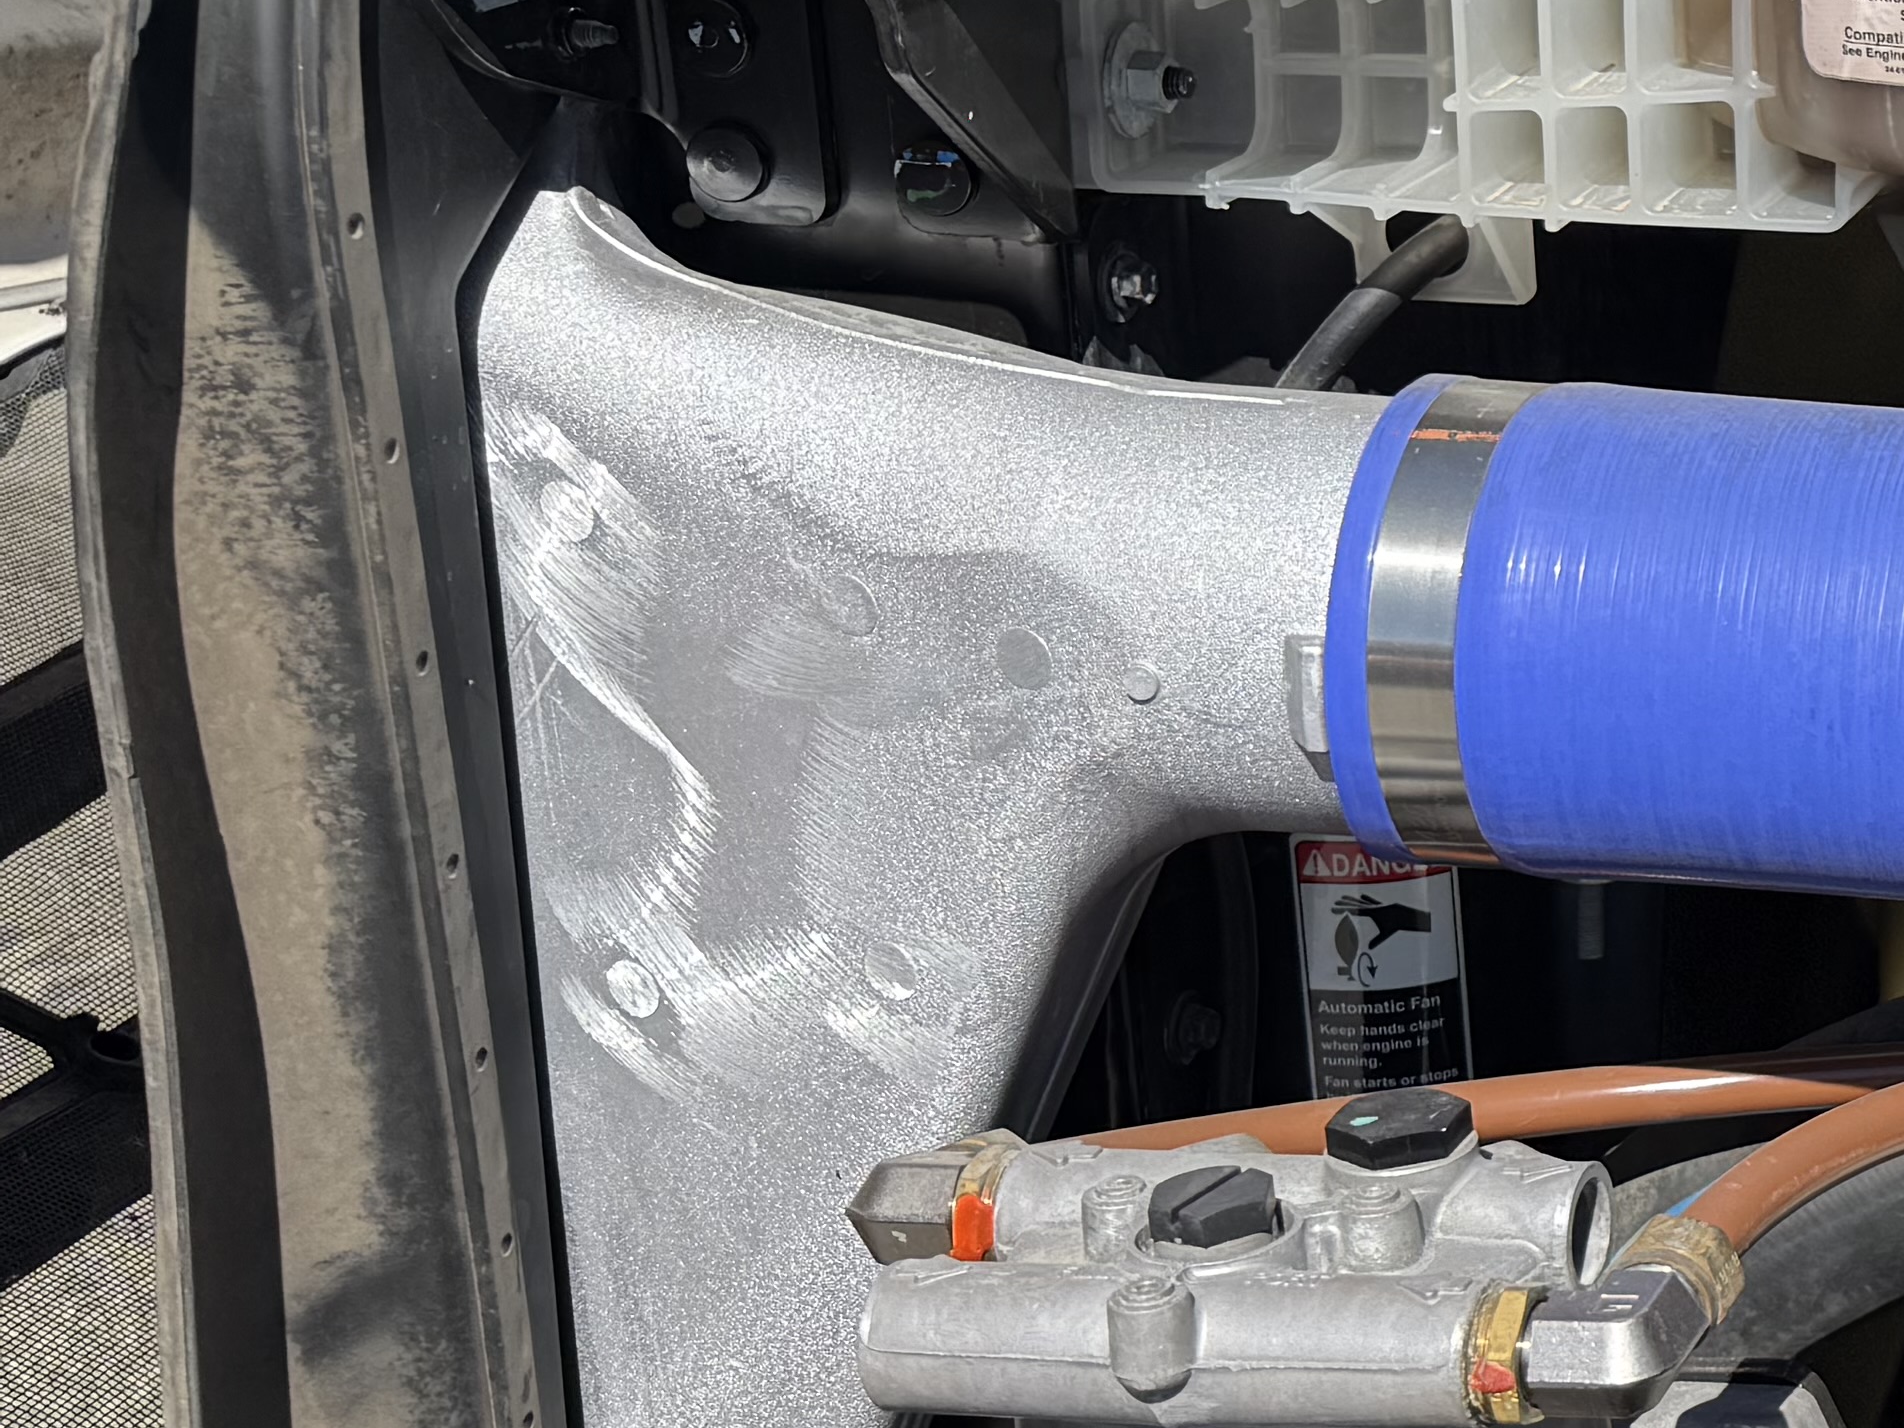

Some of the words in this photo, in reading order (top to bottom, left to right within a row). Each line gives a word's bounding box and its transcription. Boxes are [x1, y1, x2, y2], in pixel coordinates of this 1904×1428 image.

[1842, 44, 1862, 58] See
[1318, 999, 1405, 1015] Automatic
[1411, 994, 1440, 1010] Fan
[1320, 1023, 1356, 1039] Keep
[1360, 1019, 1406, 1035] hands
[1409, 1017, 1445, 1032] clear
[1321, 1038, 1358, 1052] when
[1362, 1039, 1412, 1054] engine
[1416, 1035, 1430, 1047] is
[1322, 1055, 1383, 1070] running.
[1325, 1075, 1350, 1089] Fan
[1353, 1074, 1397, 1089] starts
[1401, 1075, 1415, 1086] or
[1420, 1067, 1459, 1085] stops
